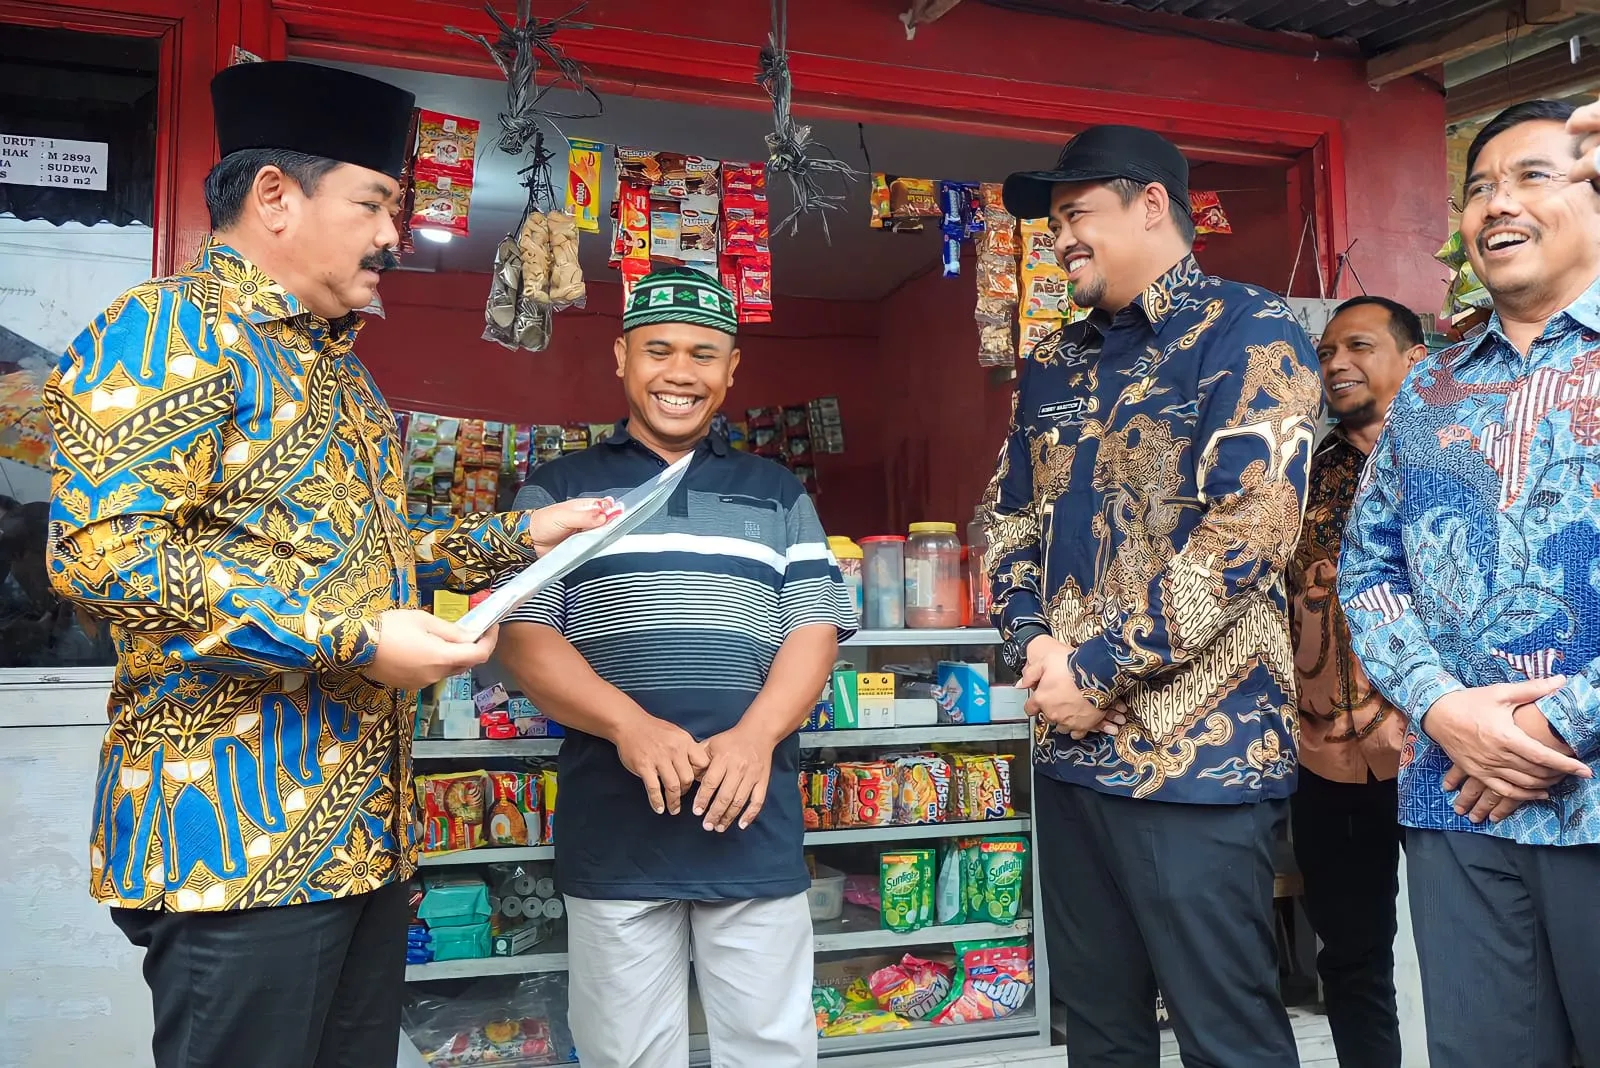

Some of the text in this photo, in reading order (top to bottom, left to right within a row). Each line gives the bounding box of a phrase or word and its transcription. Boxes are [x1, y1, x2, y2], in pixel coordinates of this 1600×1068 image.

[3, 136, 36, 147] URUT
[49, 140, 54, 149] 1
[2, 148, 29, 158] HAK
[48, 152, 58, 160] M
[62, 153, 91, 163] 2893
[47, 163, 98, 175] SUDEWA
[48, 174, 69, 183] 133
[73, 177, 91, 185] m2
[1032, 236, 1054, 248] AB
[1032, 282, 1066, 295] ABC
